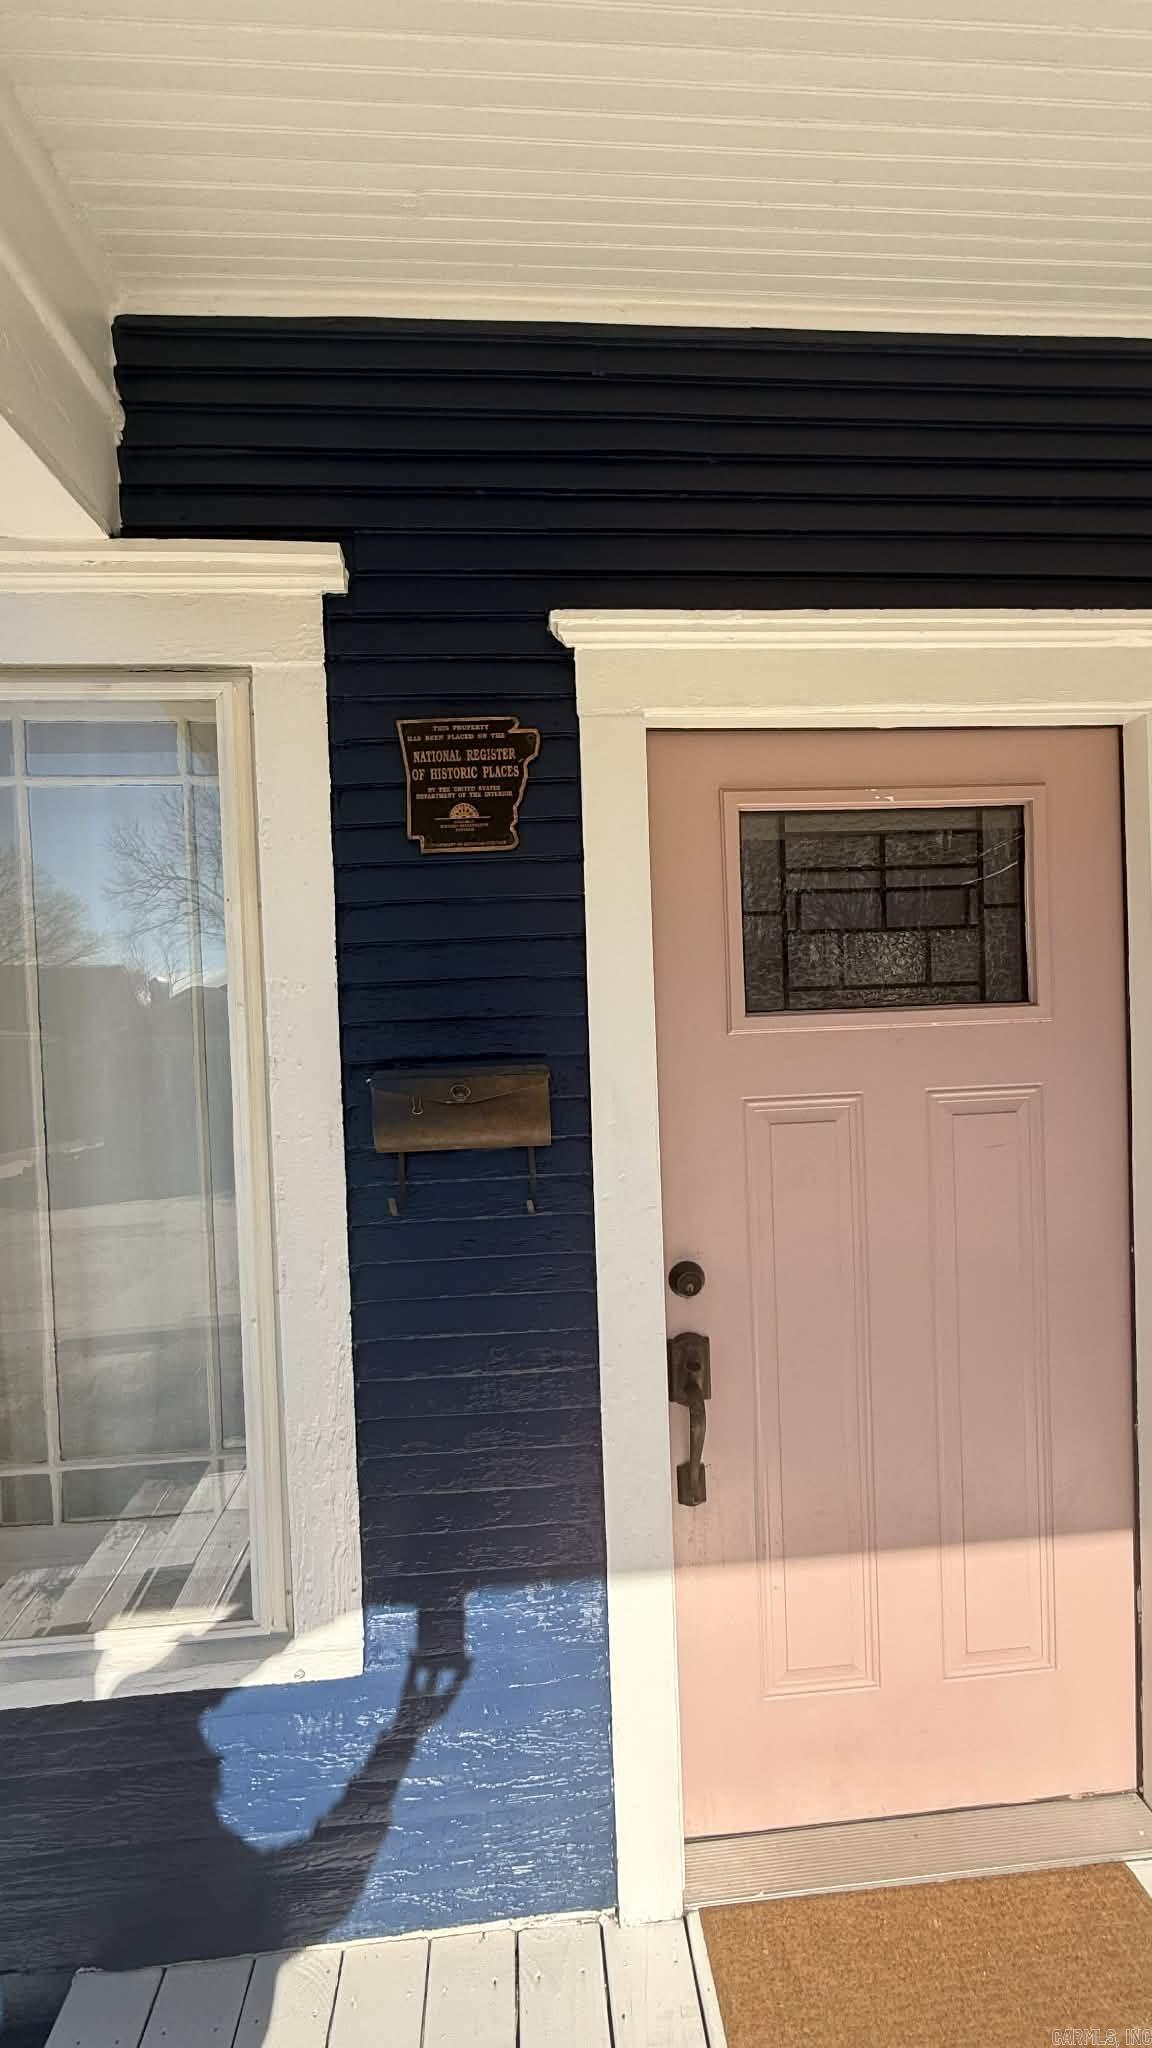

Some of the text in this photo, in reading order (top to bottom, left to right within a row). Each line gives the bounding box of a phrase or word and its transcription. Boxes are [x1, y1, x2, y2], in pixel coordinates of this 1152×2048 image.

[413, 747, 516, 763] NATIONAL REGISTER
[411, 765, 519, 781] OF HISTORIC PLACES
